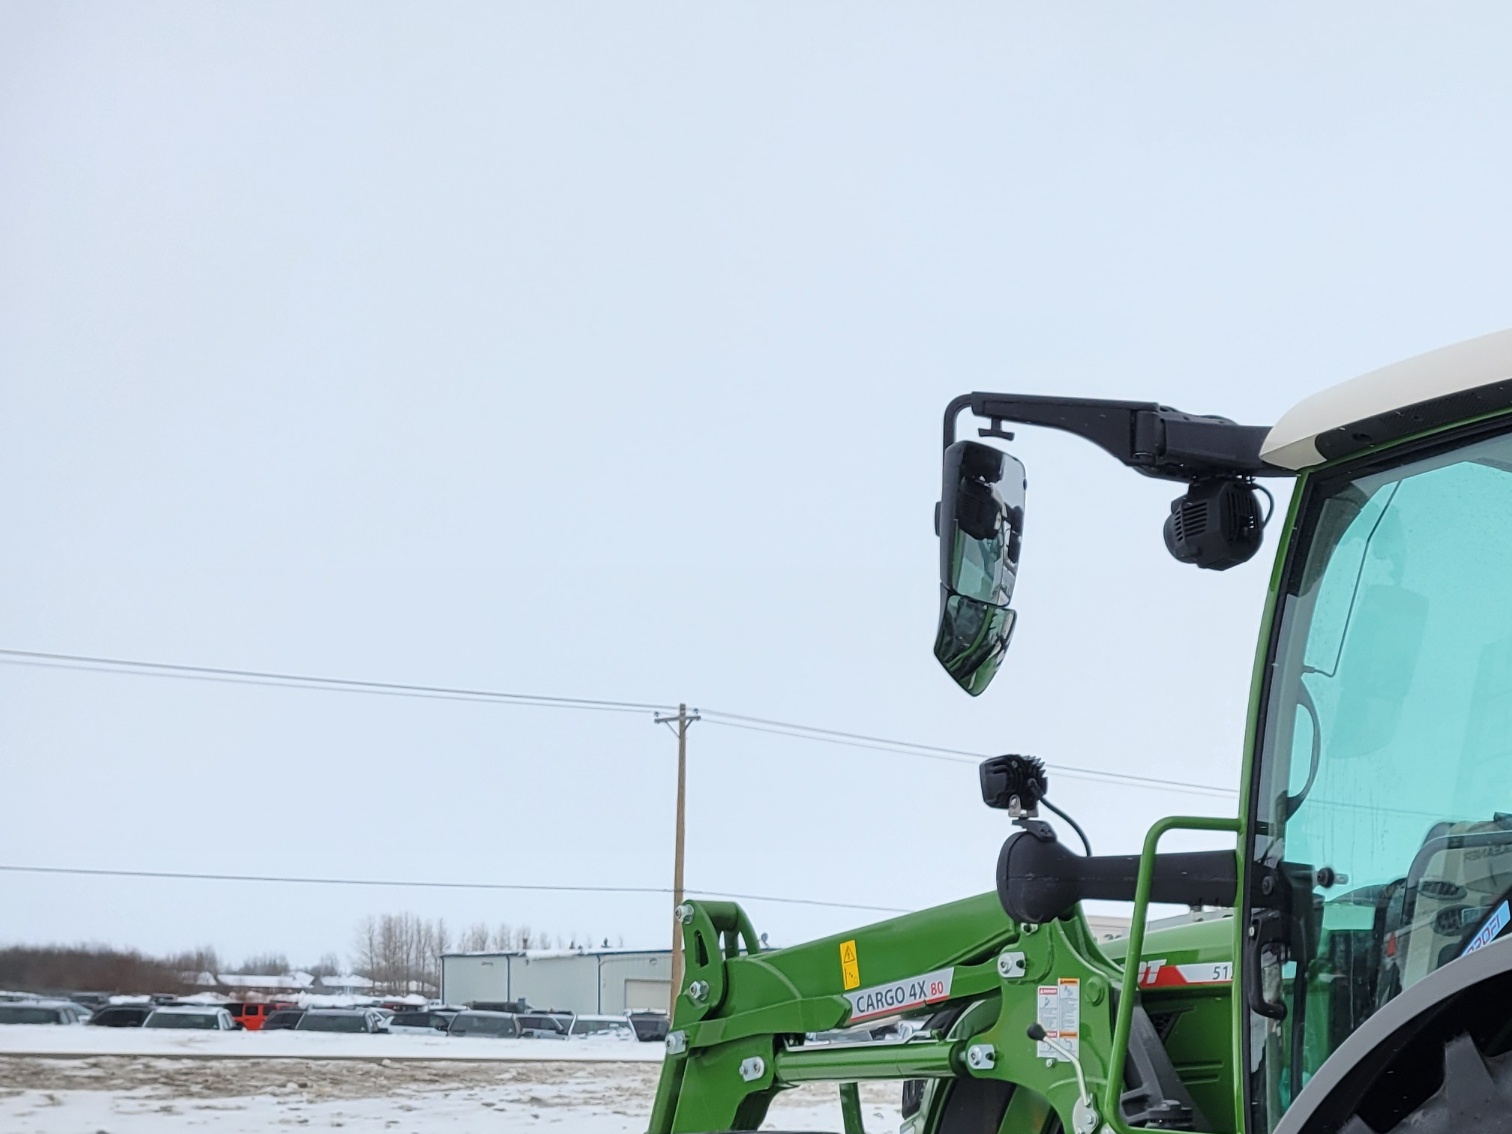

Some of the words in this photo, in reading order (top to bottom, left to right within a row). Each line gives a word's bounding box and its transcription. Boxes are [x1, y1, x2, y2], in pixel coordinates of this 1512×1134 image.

[1212, 965, 1233, 980] 51
[856, 986, 905, 1013] CARGO
[909, 980, 928, 1000] 4X
[930, 980, 944, 996] 80
